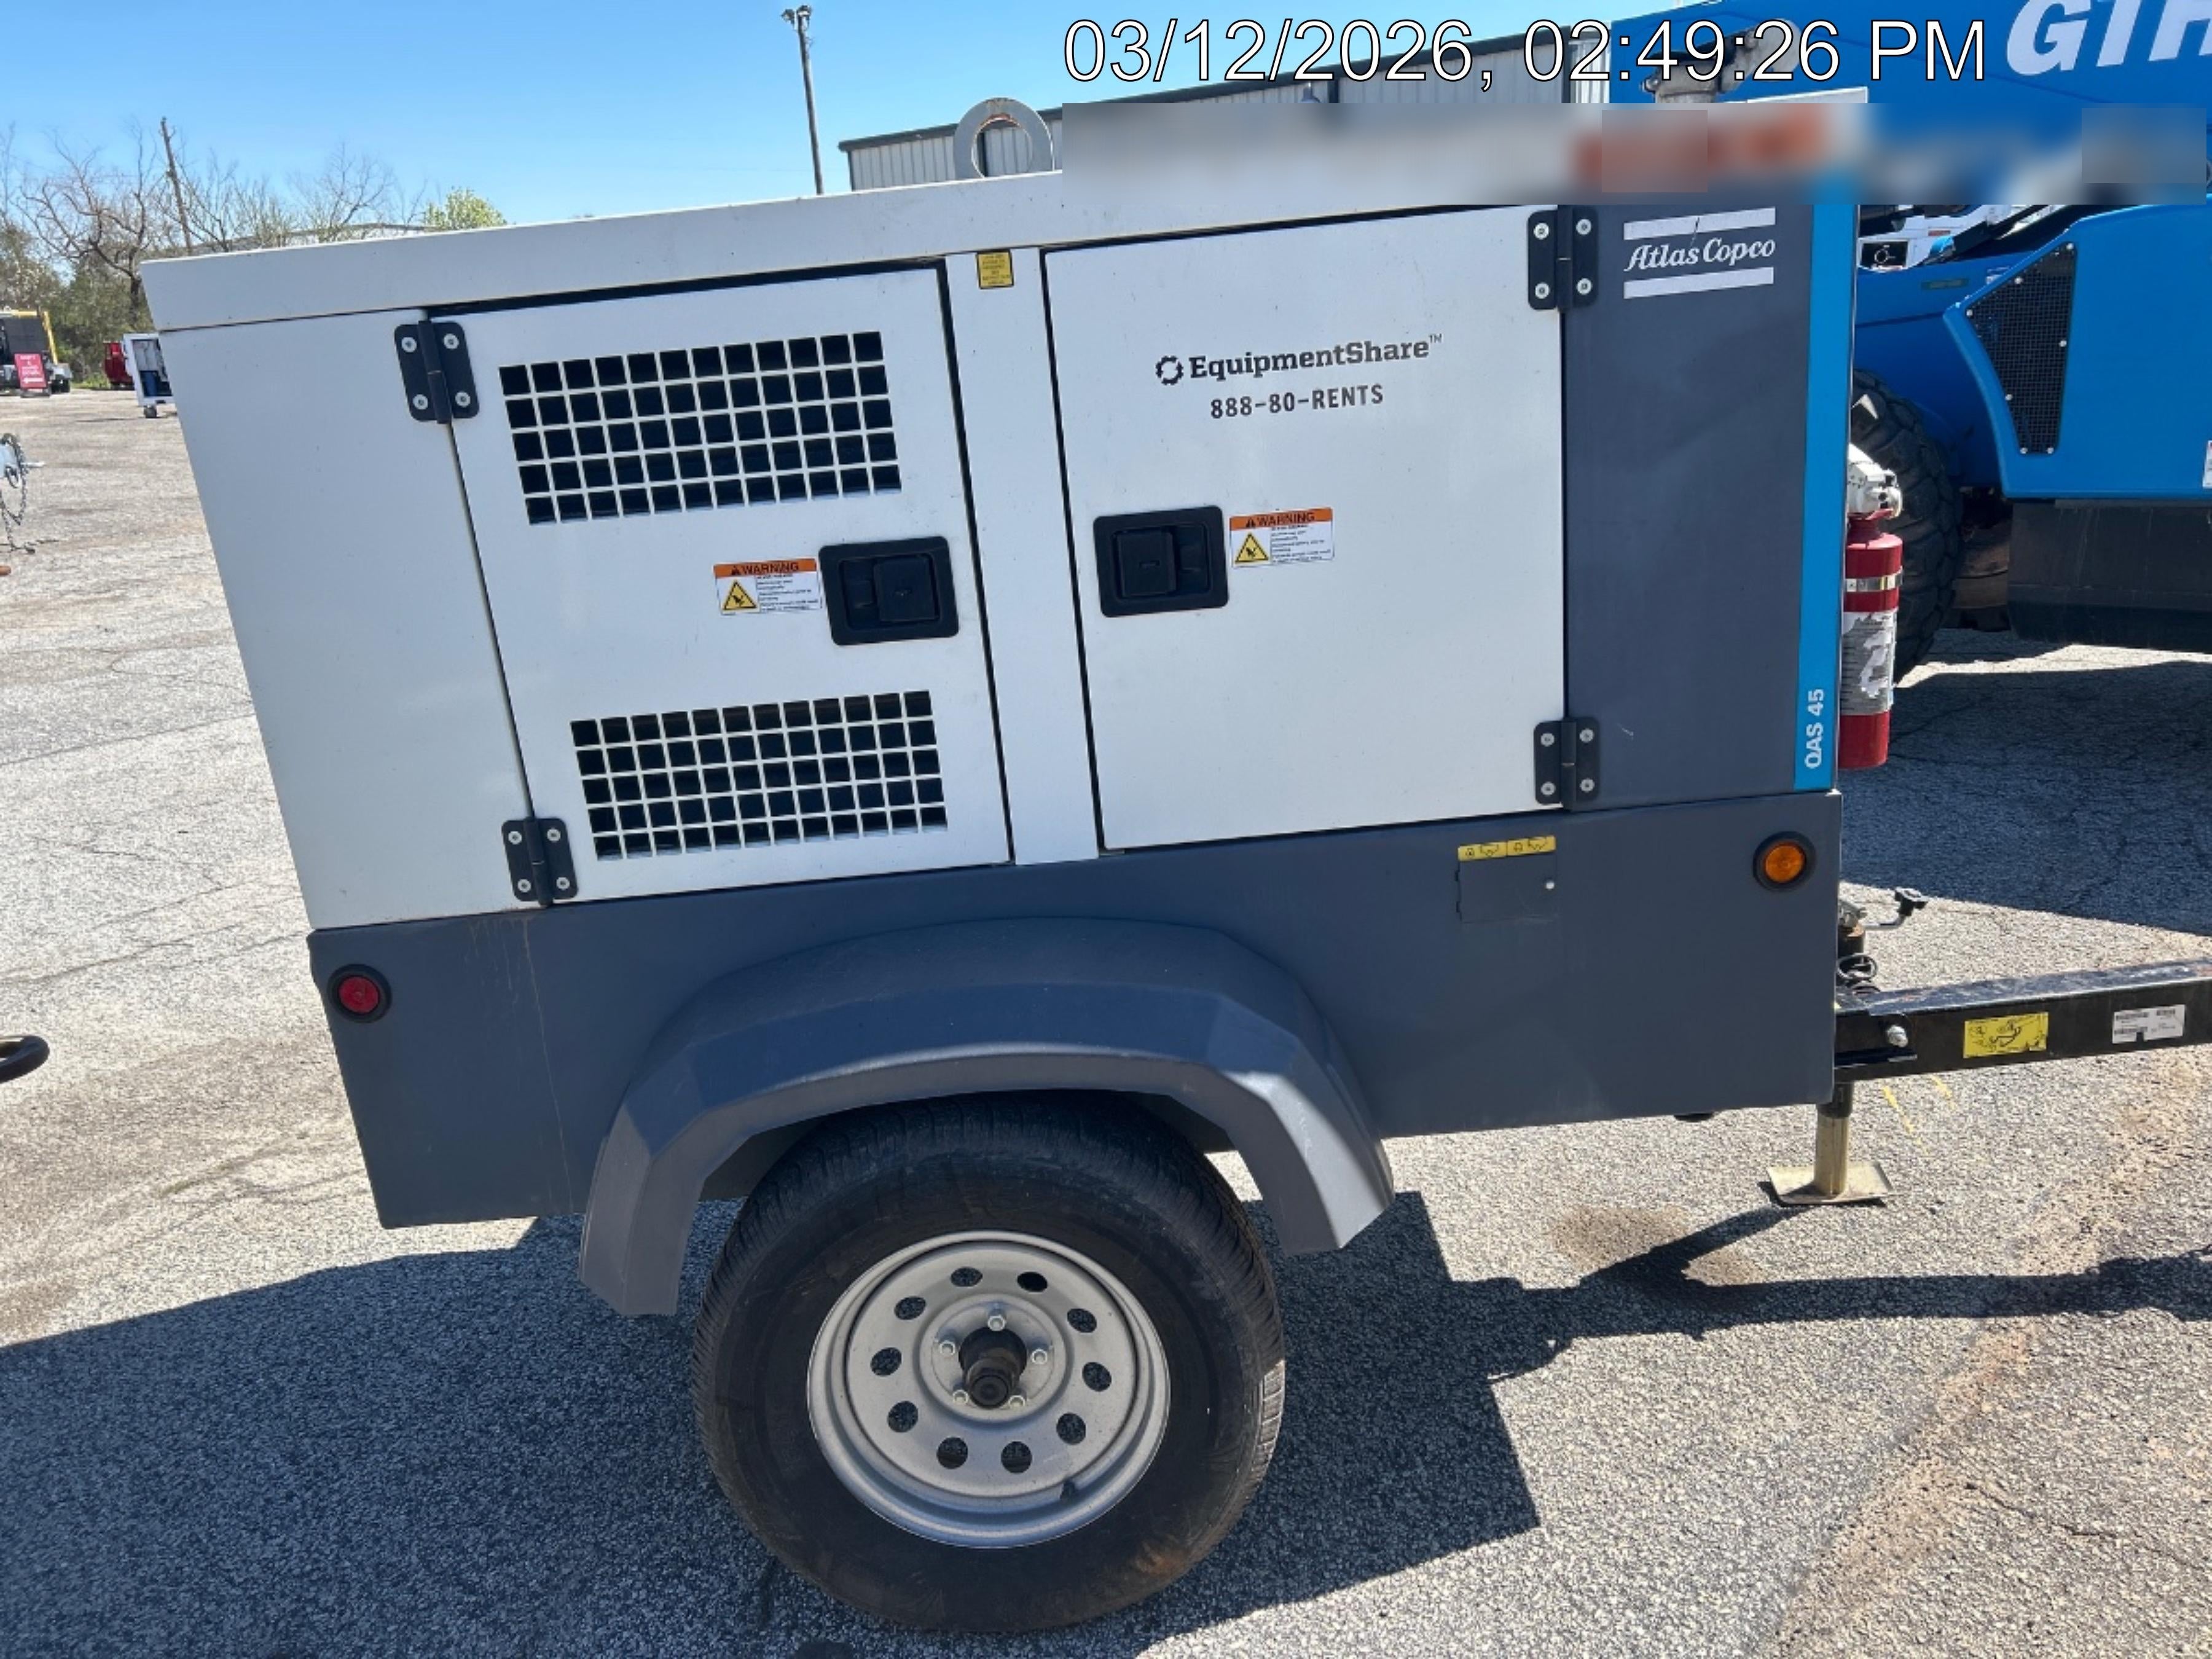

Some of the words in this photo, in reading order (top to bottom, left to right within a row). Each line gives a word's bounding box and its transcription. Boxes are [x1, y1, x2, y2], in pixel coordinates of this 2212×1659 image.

[1624, 244, 1699, 272] Atlas
[1703, 237, 1776, 266] Copco
[1210, 382, 1383, 419] 888-80-RENTS
[1257, 512, 1315, 527] WARNING
[742, 562, 798, 576] WARNING
[1808, 689, 1824, 716] 45
[1805, 722, 1824, 769] QAS
